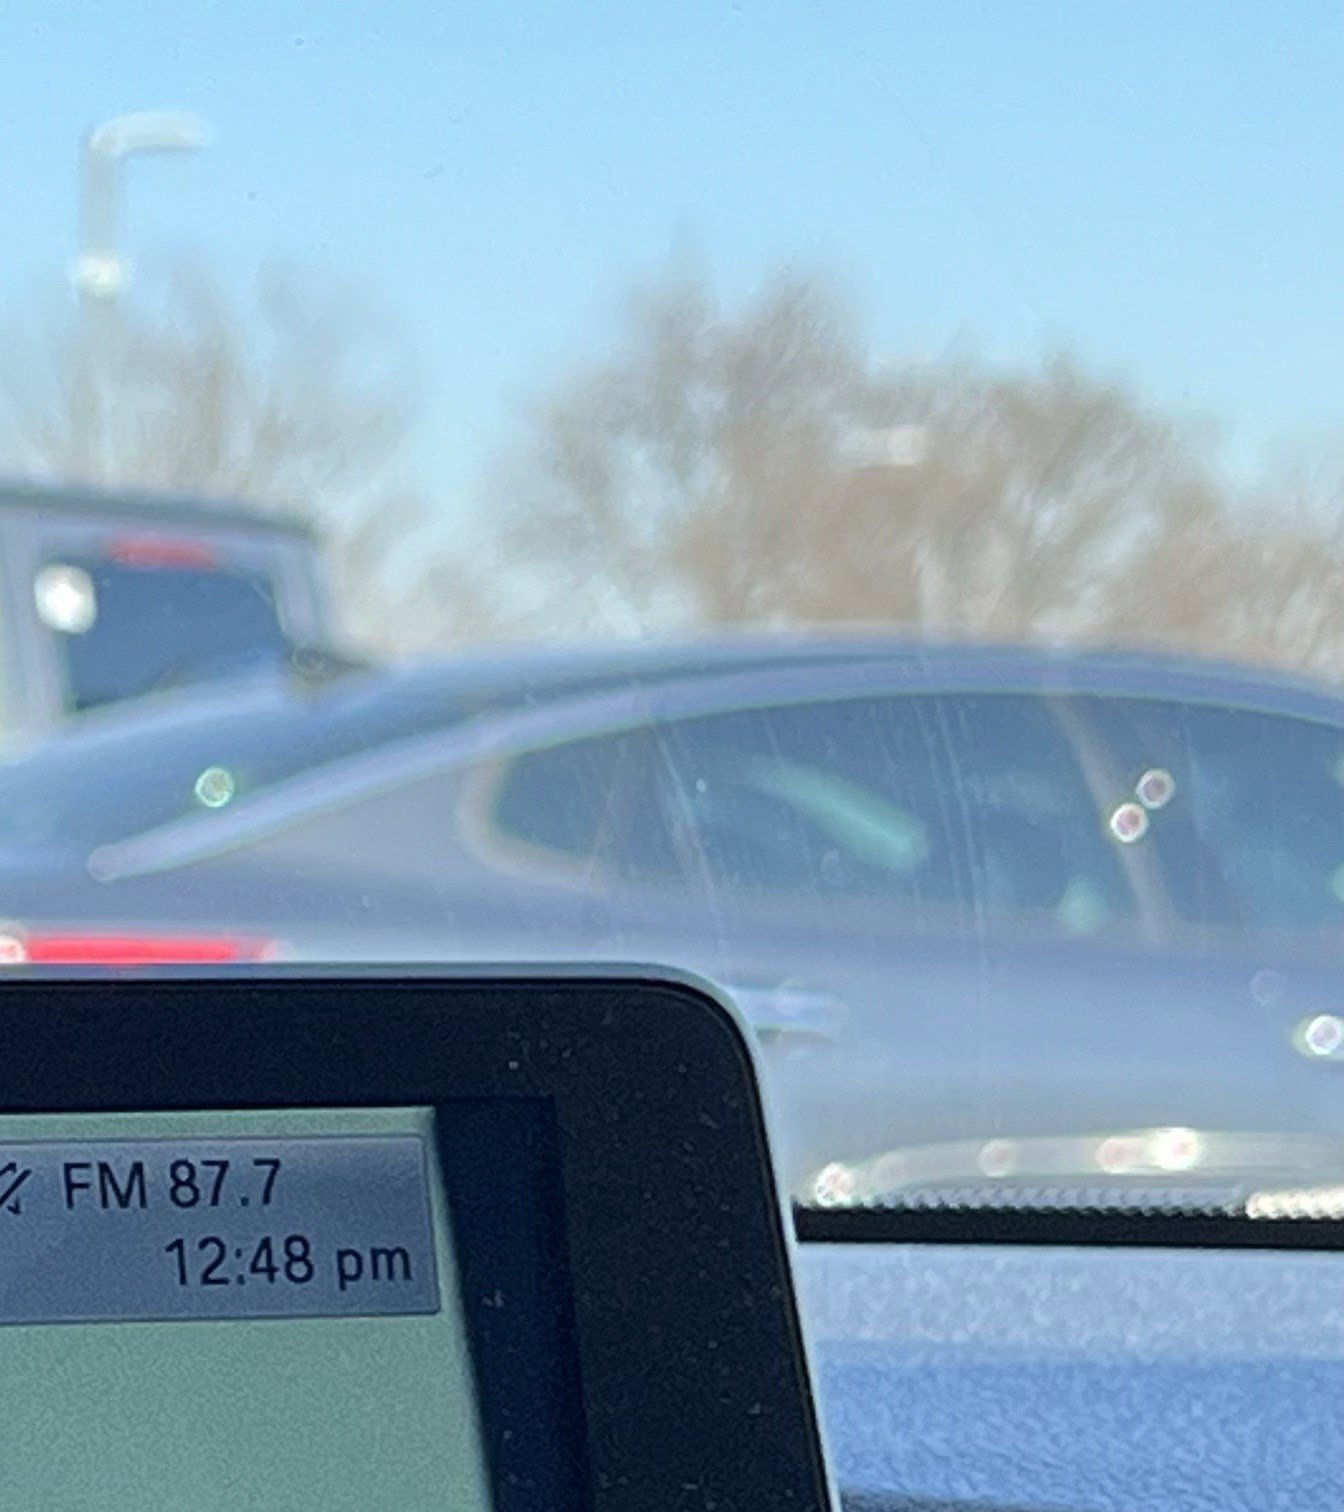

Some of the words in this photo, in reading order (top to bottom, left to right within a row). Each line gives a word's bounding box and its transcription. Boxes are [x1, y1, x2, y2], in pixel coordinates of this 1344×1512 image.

[62, 1162, 148, 1210] FM
[168, 1158, 282, 1208] 87.7
[164, 1235, 315, 1287] 12:48
[336, 1244, 412, 1292] pm
